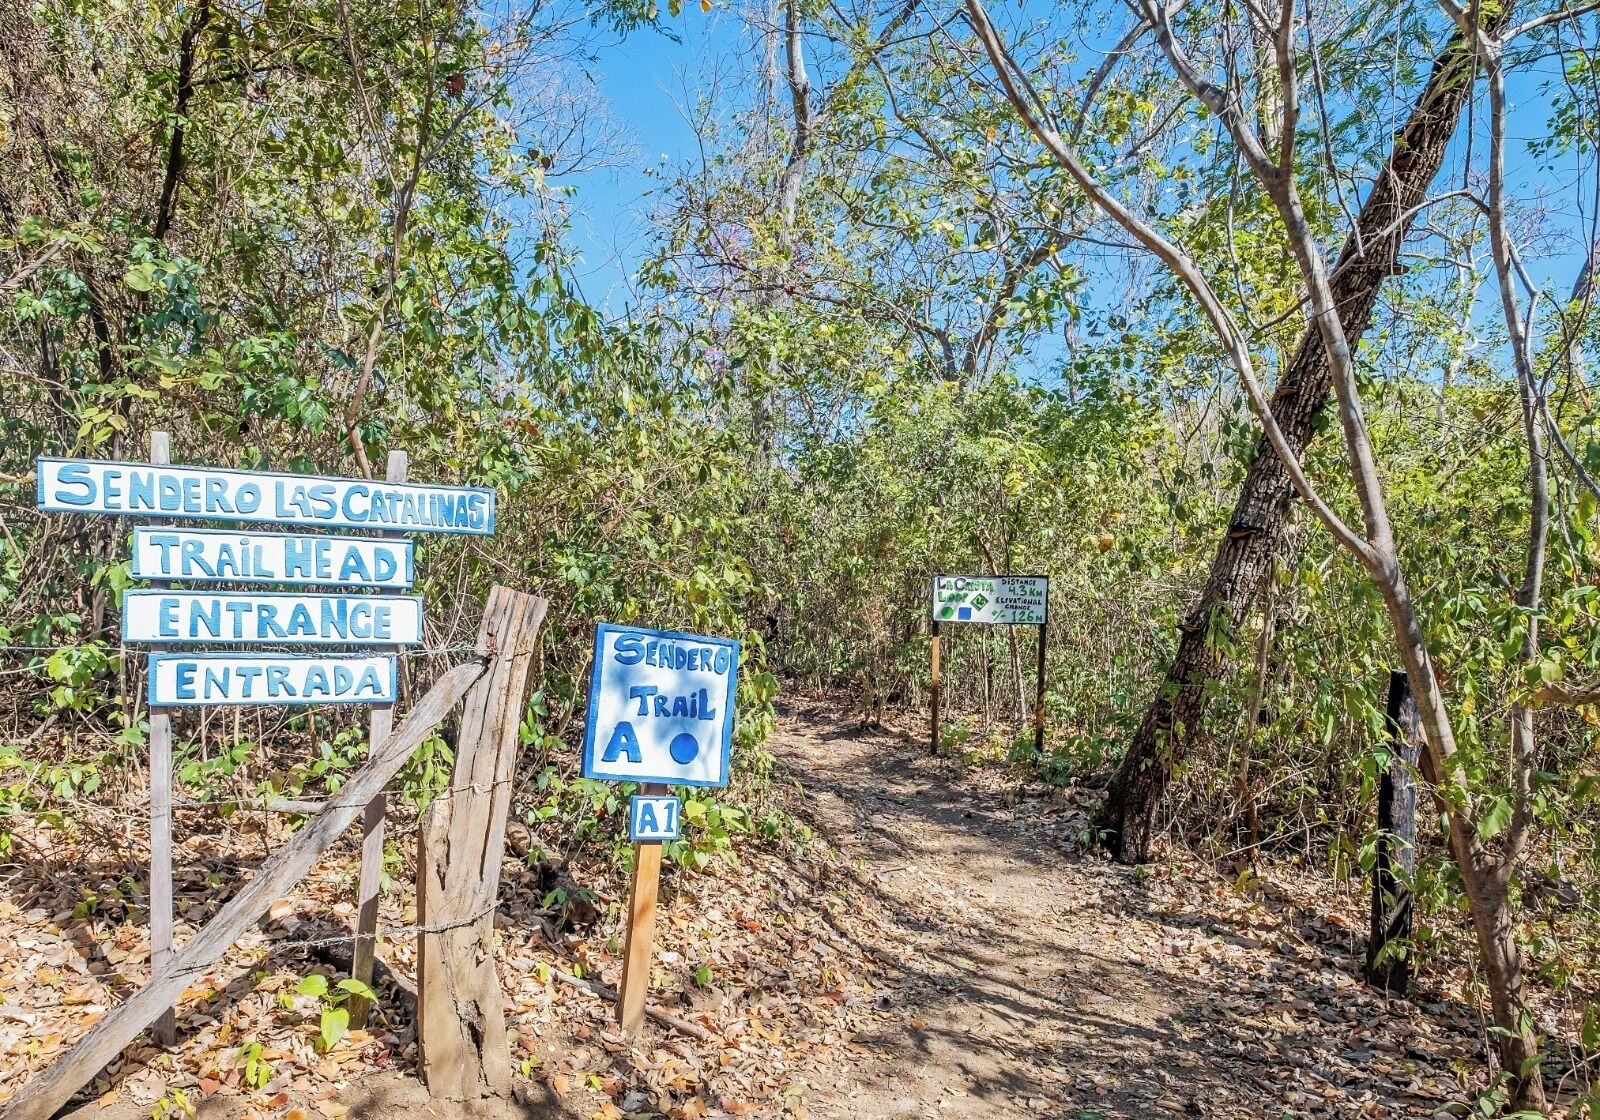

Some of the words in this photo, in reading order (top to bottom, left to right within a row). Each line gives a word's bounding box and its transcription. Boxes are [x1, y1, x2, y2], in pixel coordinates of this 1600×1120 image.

[55, 463, 260, 514] SENDERO
[274, 481, 338, 520] LAS
[284, 538, 398, 582] HEAD
[159, 598, 391, 639] ENTRANCE
[614, 633, 730, 674] SENDERO
[175, 662, 383, 700] ENTRADA
[601, 721, 642, 763] A
[638, 802, 675, 834] A1
